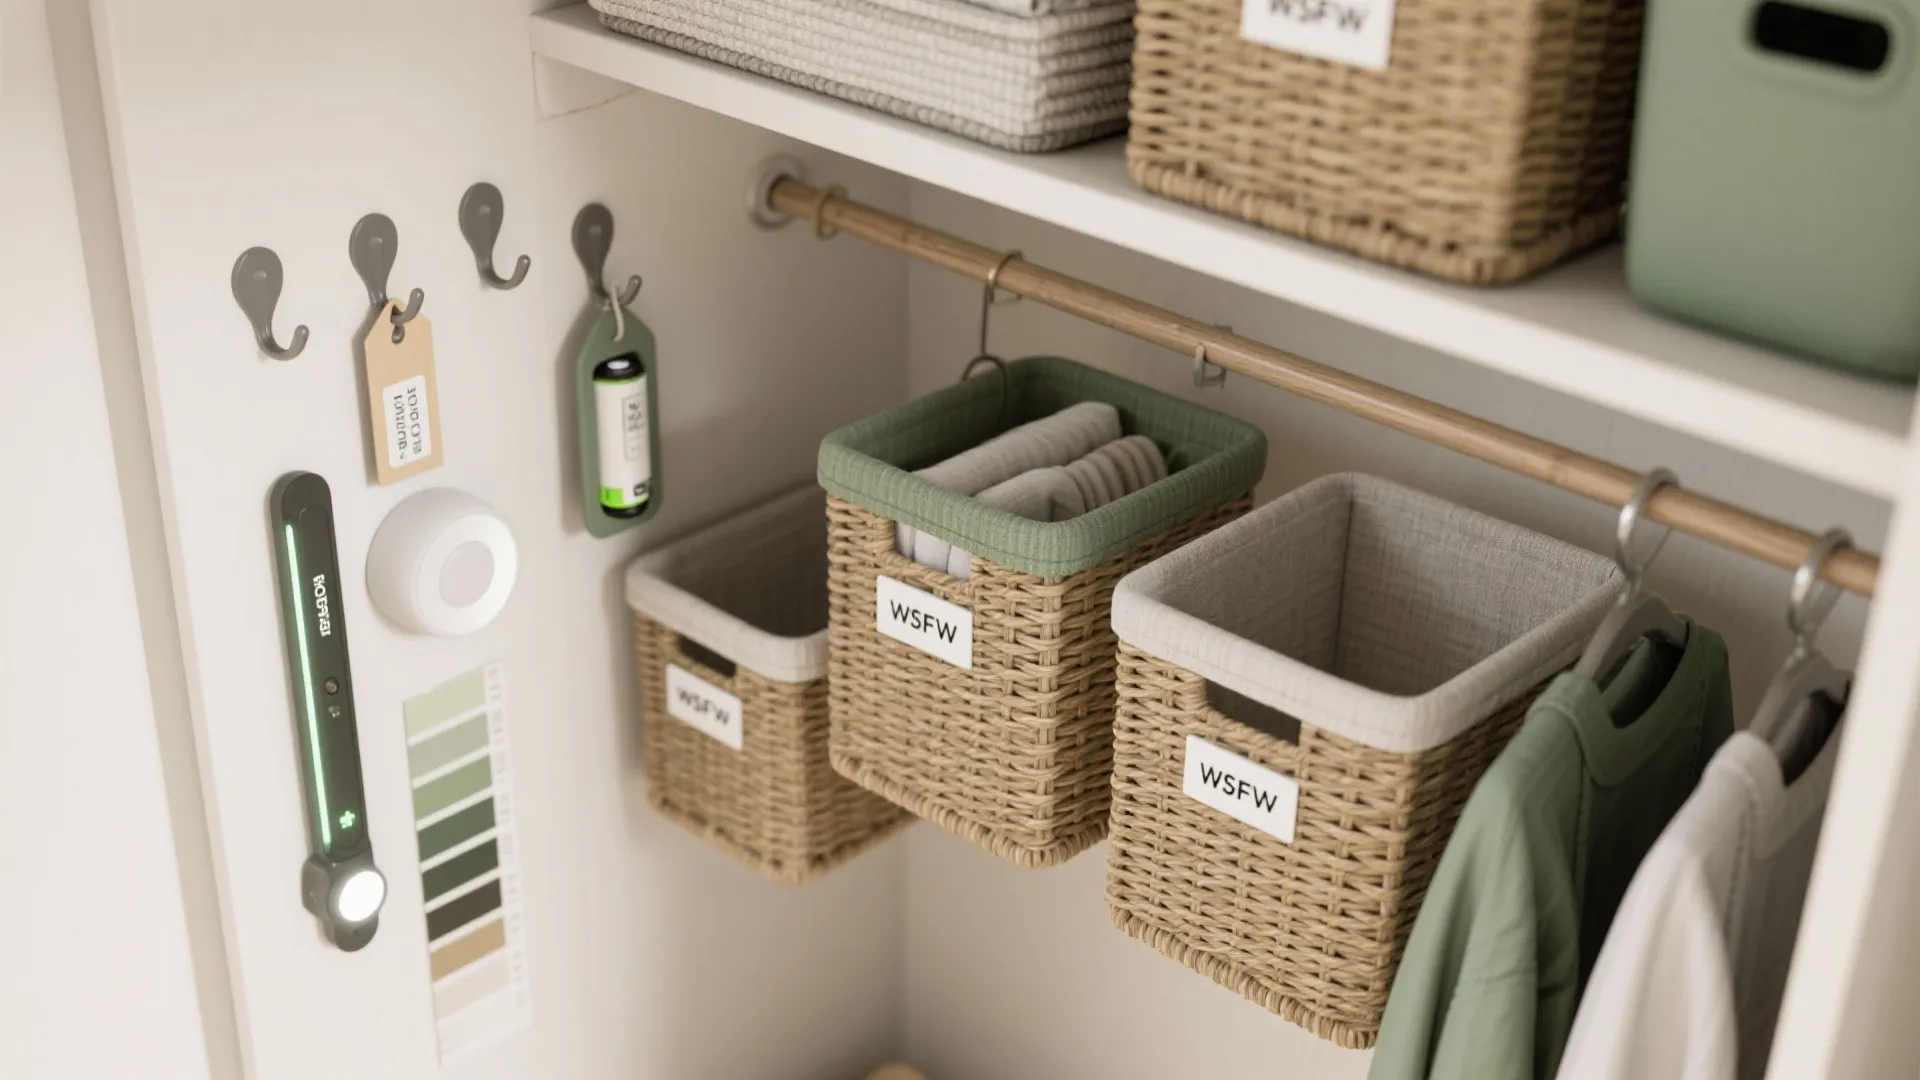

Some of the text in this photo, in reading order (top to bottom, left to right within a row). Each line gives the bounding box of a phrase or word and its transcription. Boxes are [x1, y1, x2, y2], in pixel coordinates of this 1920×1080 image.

[890, 599, 957, 643] WSFW
[676, 686, 729, 725] WSFW
[1200, 762, 1277, 813] WSFW
